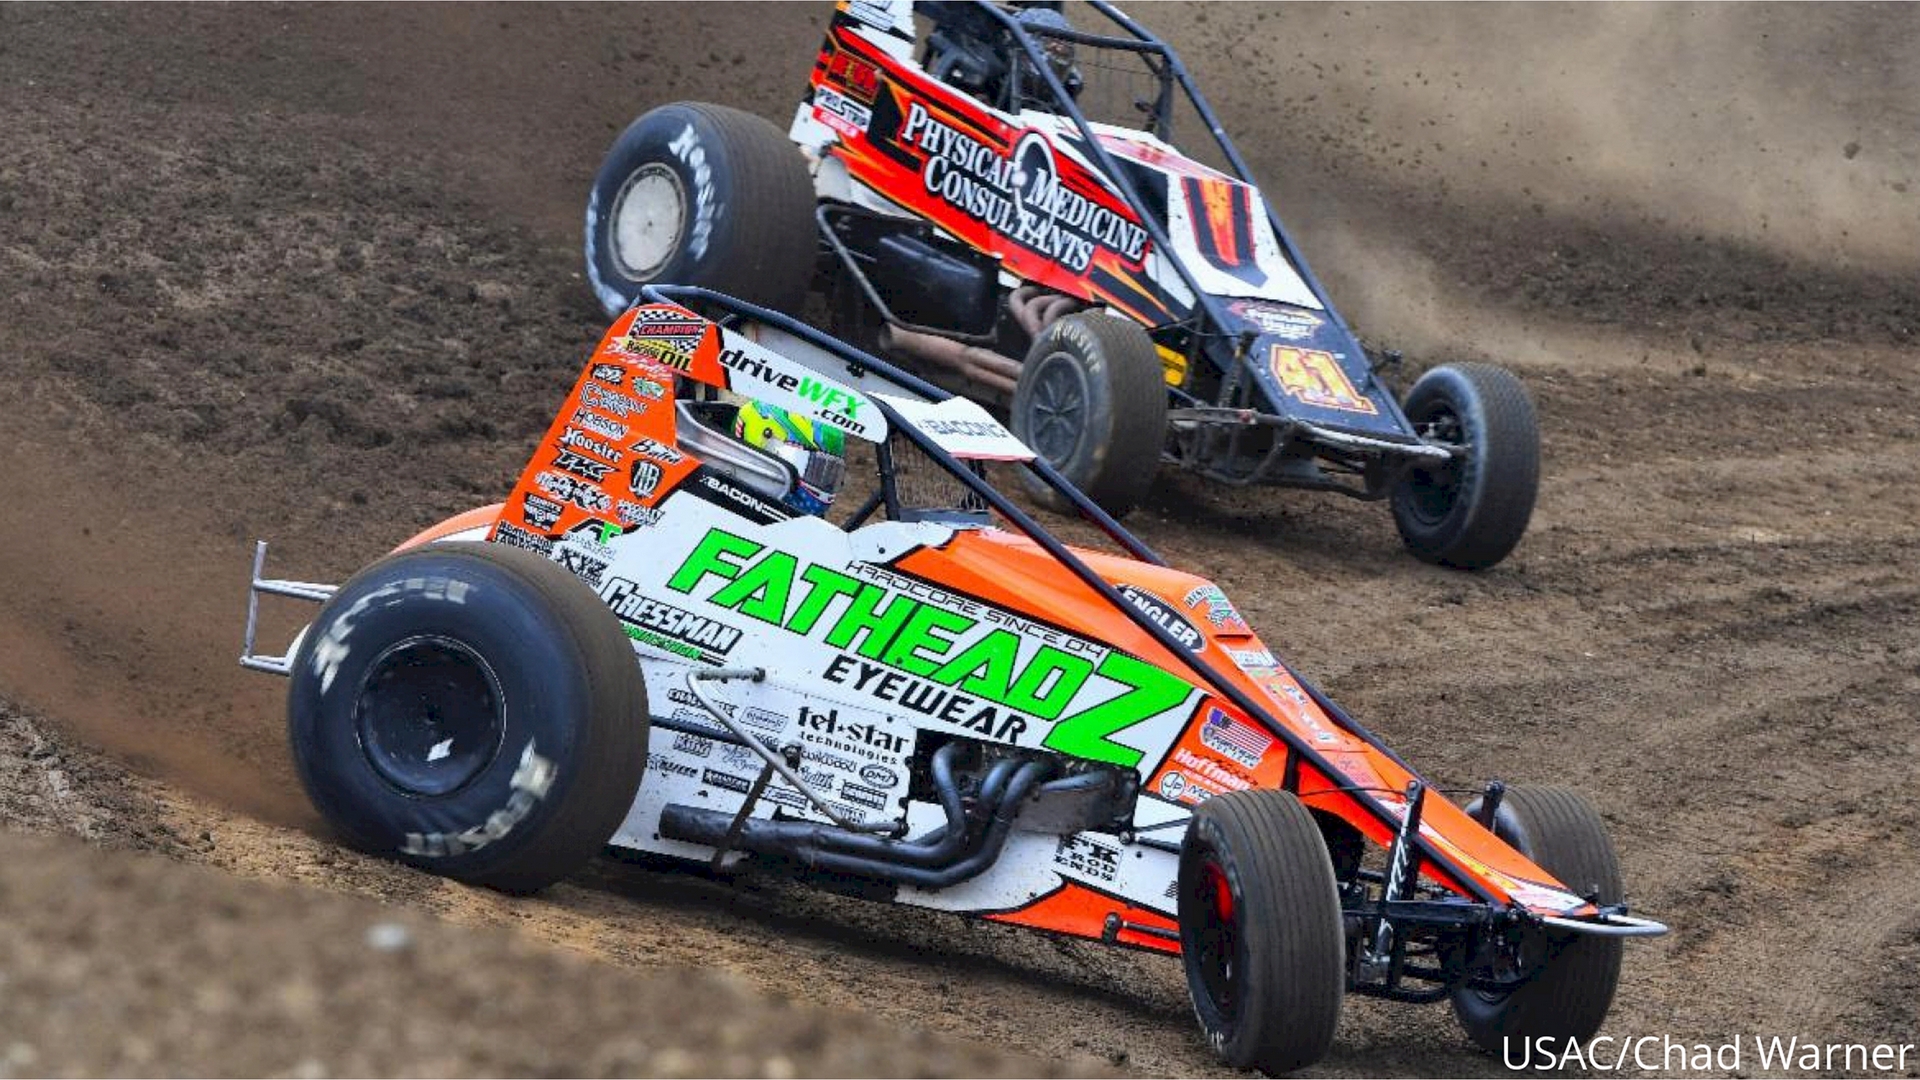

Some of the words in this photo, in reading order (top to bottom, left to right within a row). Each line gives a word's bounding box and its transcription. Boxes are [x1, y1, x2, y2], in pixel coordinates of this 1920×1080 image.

[902, 101, 1021, 194] PHYSICAL
[1021, 167, 1148, 262] MEDICINE
[923, 156, 1095, 272] CONSULTANTS
[639, 324, 701, 335] CHAMPION
[659, 350, 694, 372] OIL
[1273, 347, 1374, 412] 41
[560, 427, 622, 463] Hoosier
[573, 408, 627, 436] HOBSON
[707, 476, 764, 514] BACON
[846, 561, 983, 616] HARDCORE
[986, 609, 1062, 643] SINCE
[1122, 590, 1200, 648] ENGLER
[667, 528, 1196, 767] FATHEADZ
[823, 655, 1027, 745] EYEWEAR
[799, 731, 898, 765] technologies
